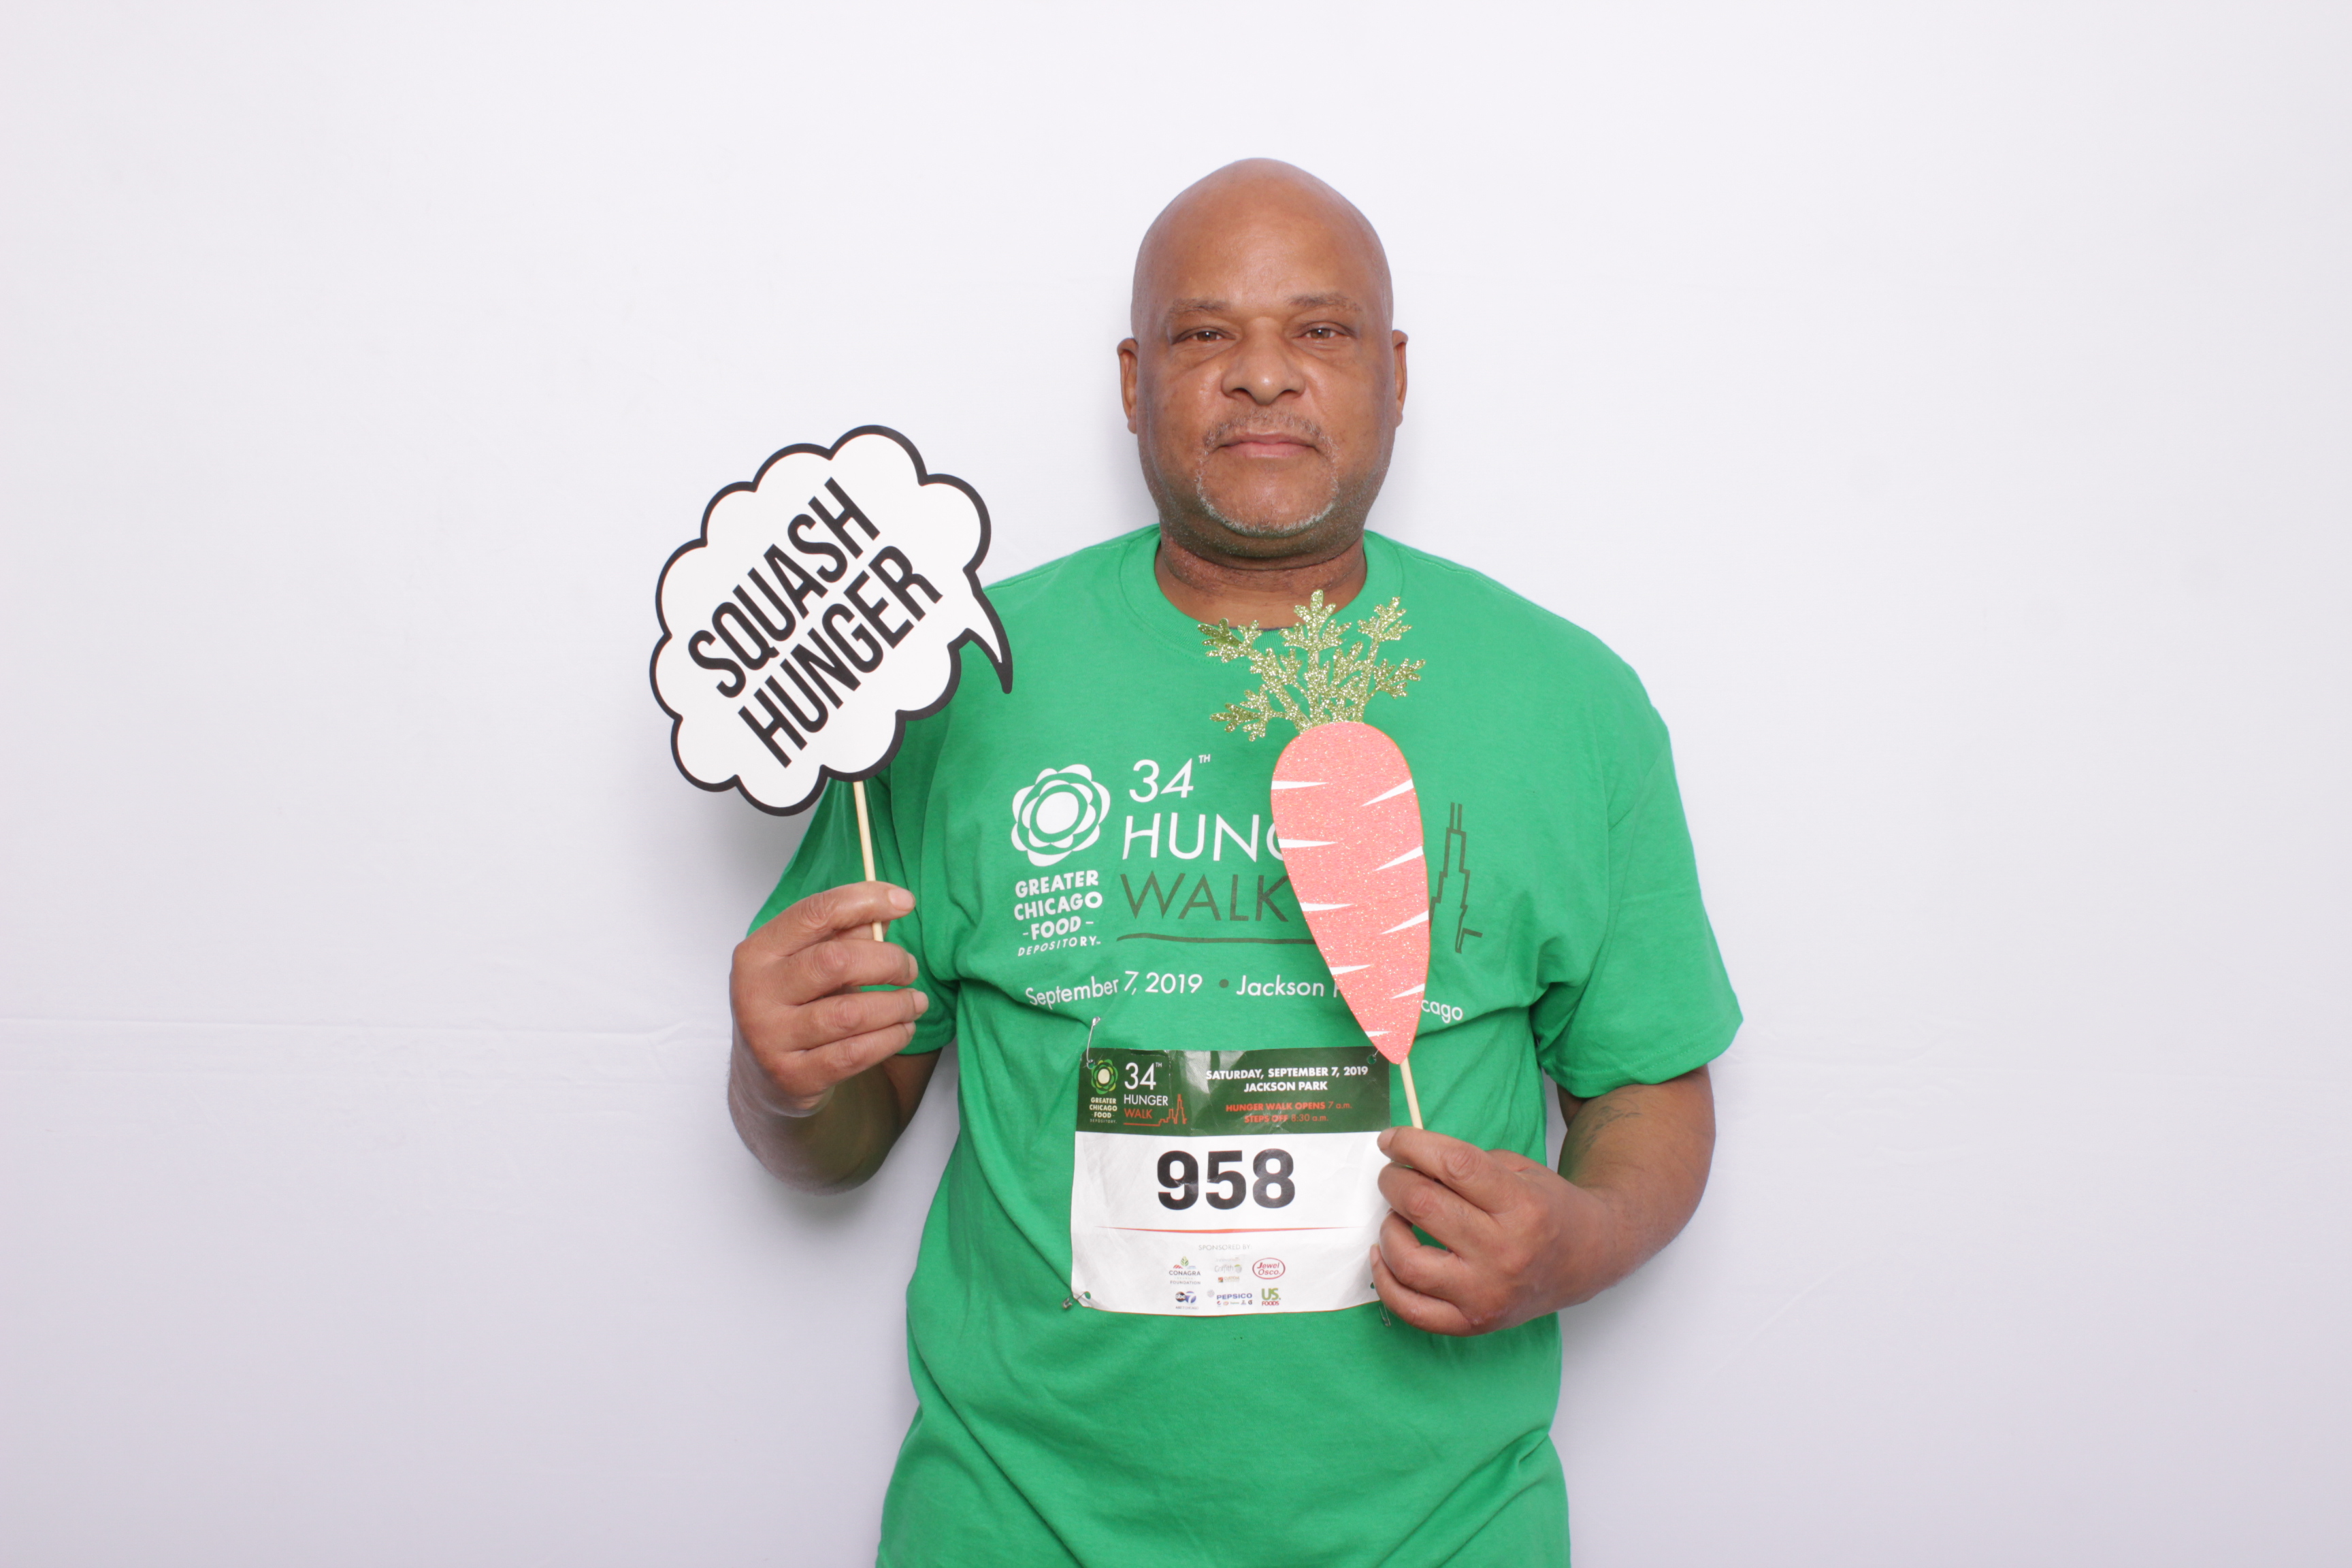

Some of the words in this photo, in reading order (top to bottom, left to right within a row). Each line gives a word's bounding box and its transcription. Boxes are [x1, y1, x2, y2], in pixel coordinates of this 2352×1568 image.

[688, 476, 881, 698] SQUASH
[738, 545, 943, 768] HUNGER
[1122, 813, 1284, 862] HUN
[1015, 870, 1099, 898] GREATER
[1120, 870, 1290, 922] WALK
[1014, 891, 1103, 920] CHICAGO
[1025, 976, 1119, 1009] September
[1124, 970, 1139, 995] 7,
[1145, 972, 1203, 994] 2019
[1236, 975, 1324, 996] Jackson
[1420, 999, 1463, 1023] cago
[1206, 1068, 1264, 1080] SATURDAY,
[1268, 1068, 1328, 1078] SEPTEMBER
[1331, 1066, 1340, 1078] 7,
[1343, 1066, 1369, 1076] 2019
[1243, 1082, 1296, 1092] JACKSON
[1298, 1081, 1328, 1090] PARK
[1124, 1094, 1169, 1106] HUNGER
[1124, 1108, 1153, 1119] WALK
[1226, 1103, 1264, 1111] HUNGER
[1265, 1102, 1293, 1111] WALK
[1294, 1102, 1326, 1110] OPENS
[1244, 1115, 1270, 1123] STEPS
[1271, 1115, 1288, 1123] OFF
[1291, 1114, 1310, 1122] 8:30
[1157, 1148, 1296, 1210] 958
